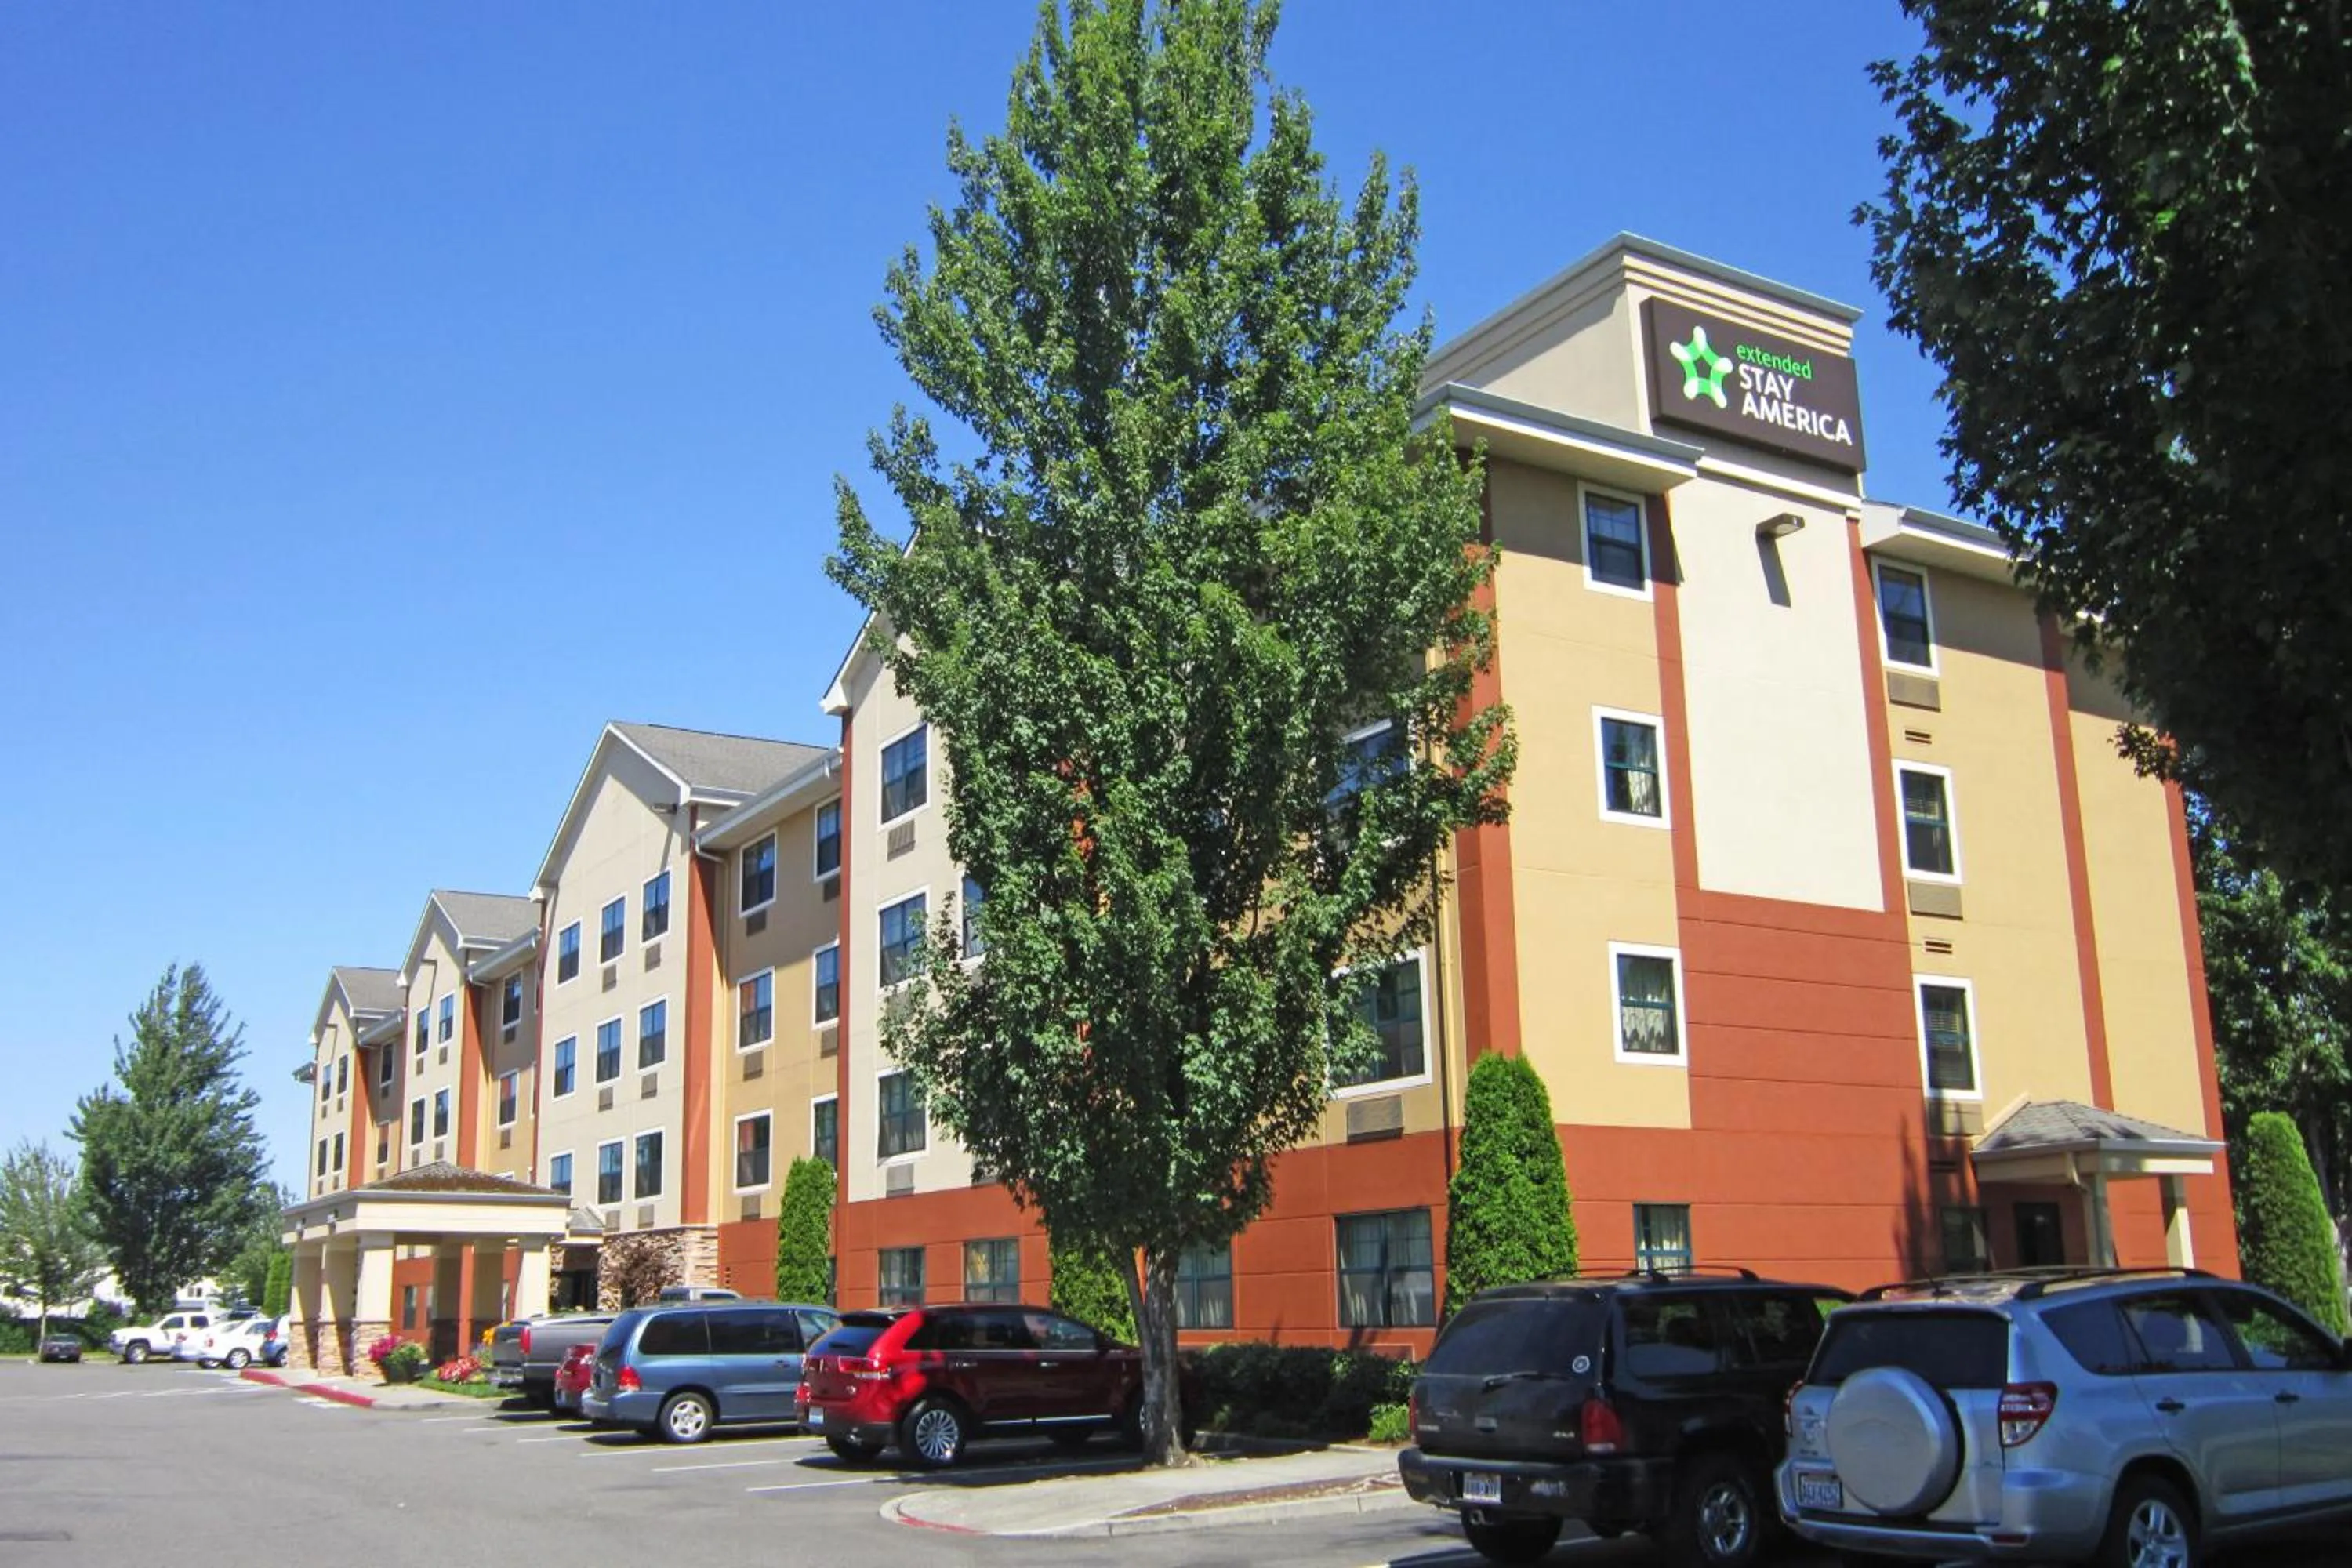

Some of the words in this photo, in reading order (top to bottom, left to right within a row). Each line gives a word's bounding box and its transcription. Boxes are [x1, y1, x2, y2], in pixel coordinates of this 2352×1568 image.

[1737, 344, 1811, 379] extended
[1738, 364, 1794, 401] STAY
[1741, 392, 1853, 445] AMERICA
